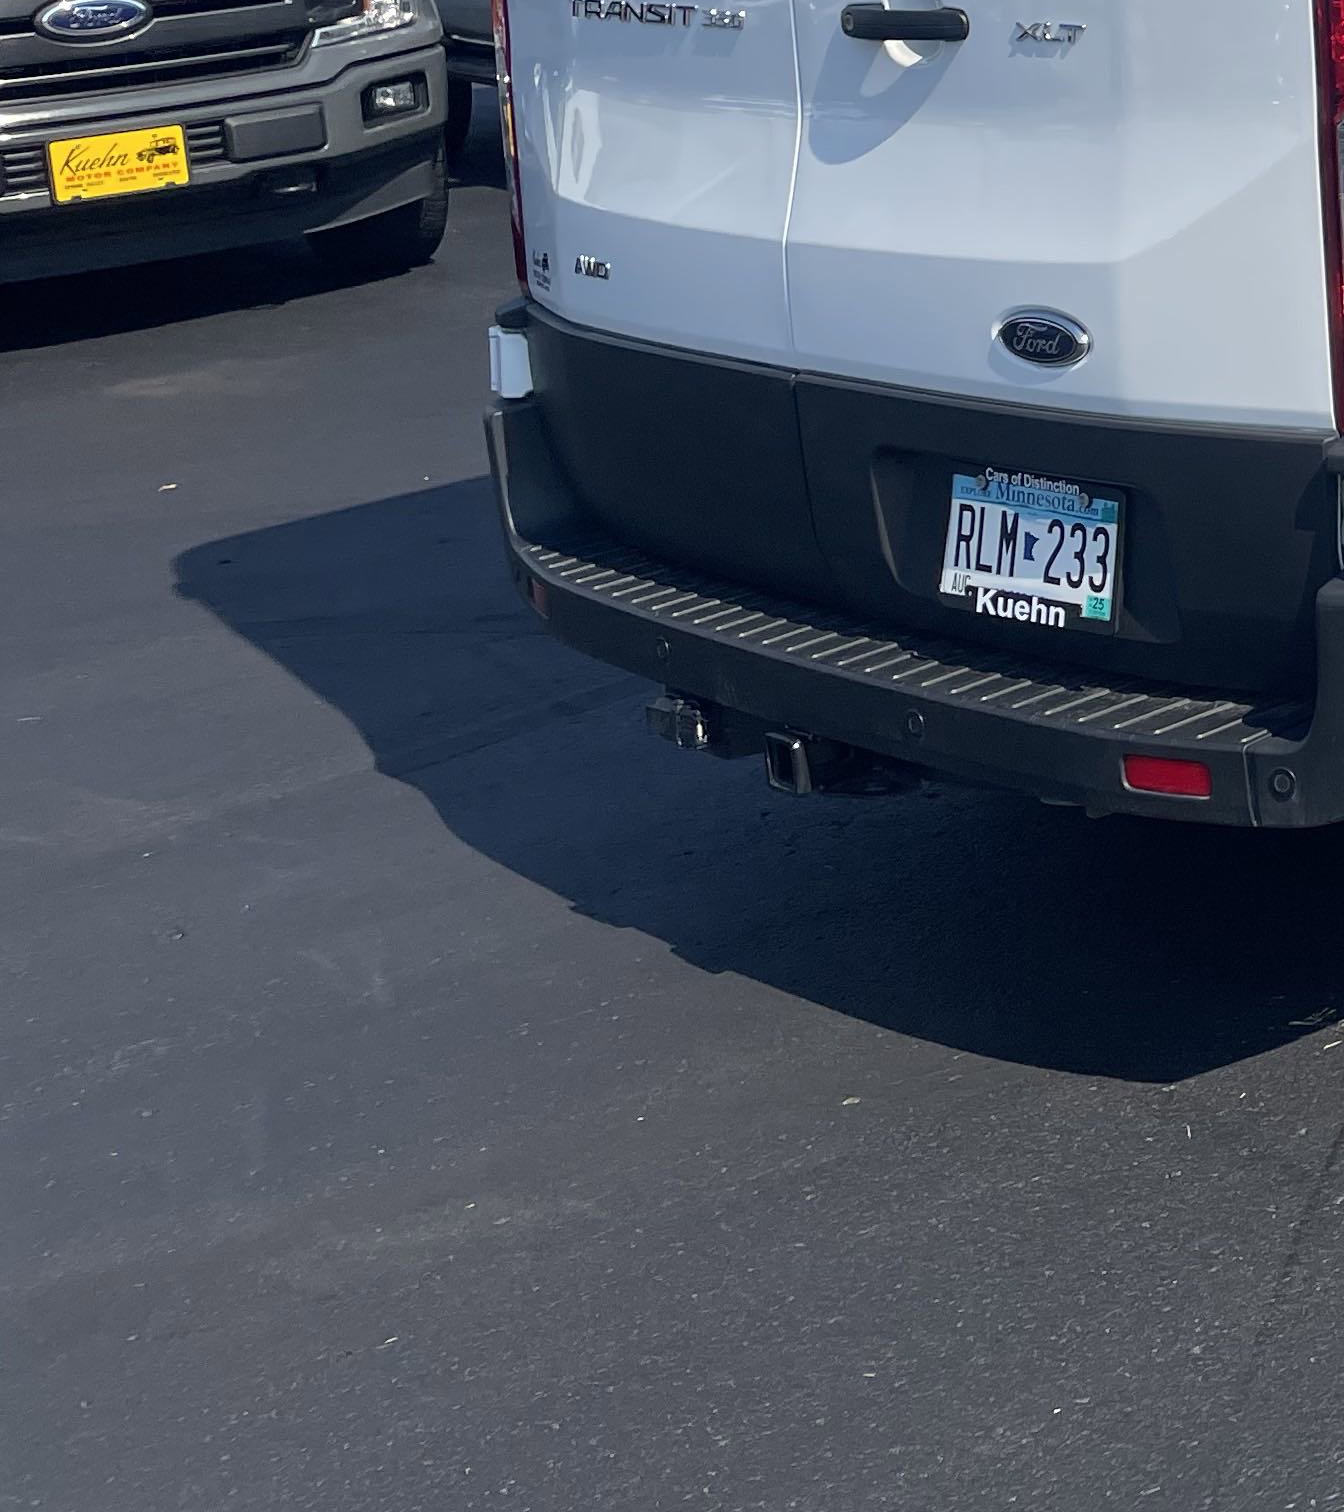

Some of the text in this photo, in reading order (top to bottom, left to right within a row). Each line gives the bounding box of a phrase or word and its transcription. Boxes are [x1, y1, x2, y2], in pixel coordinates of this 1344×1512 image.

[1015, 20, 1087, 44] XLT
[60, 143, 129, 176] Kuehn
[65, 170, 112, 182] MOTOR
[117, 161, 179, 176] COMPANY
[574, 254, 611, 280] AWD
[1012, 322, 1061, 354] Ford
[985, 467, 1080, 496] Cars of Distinction
[953, 503, 1110, 593] RLM 233
[975, 587, 1066, 628] Kuehn
[1092, 597, 1105, 611] 25
